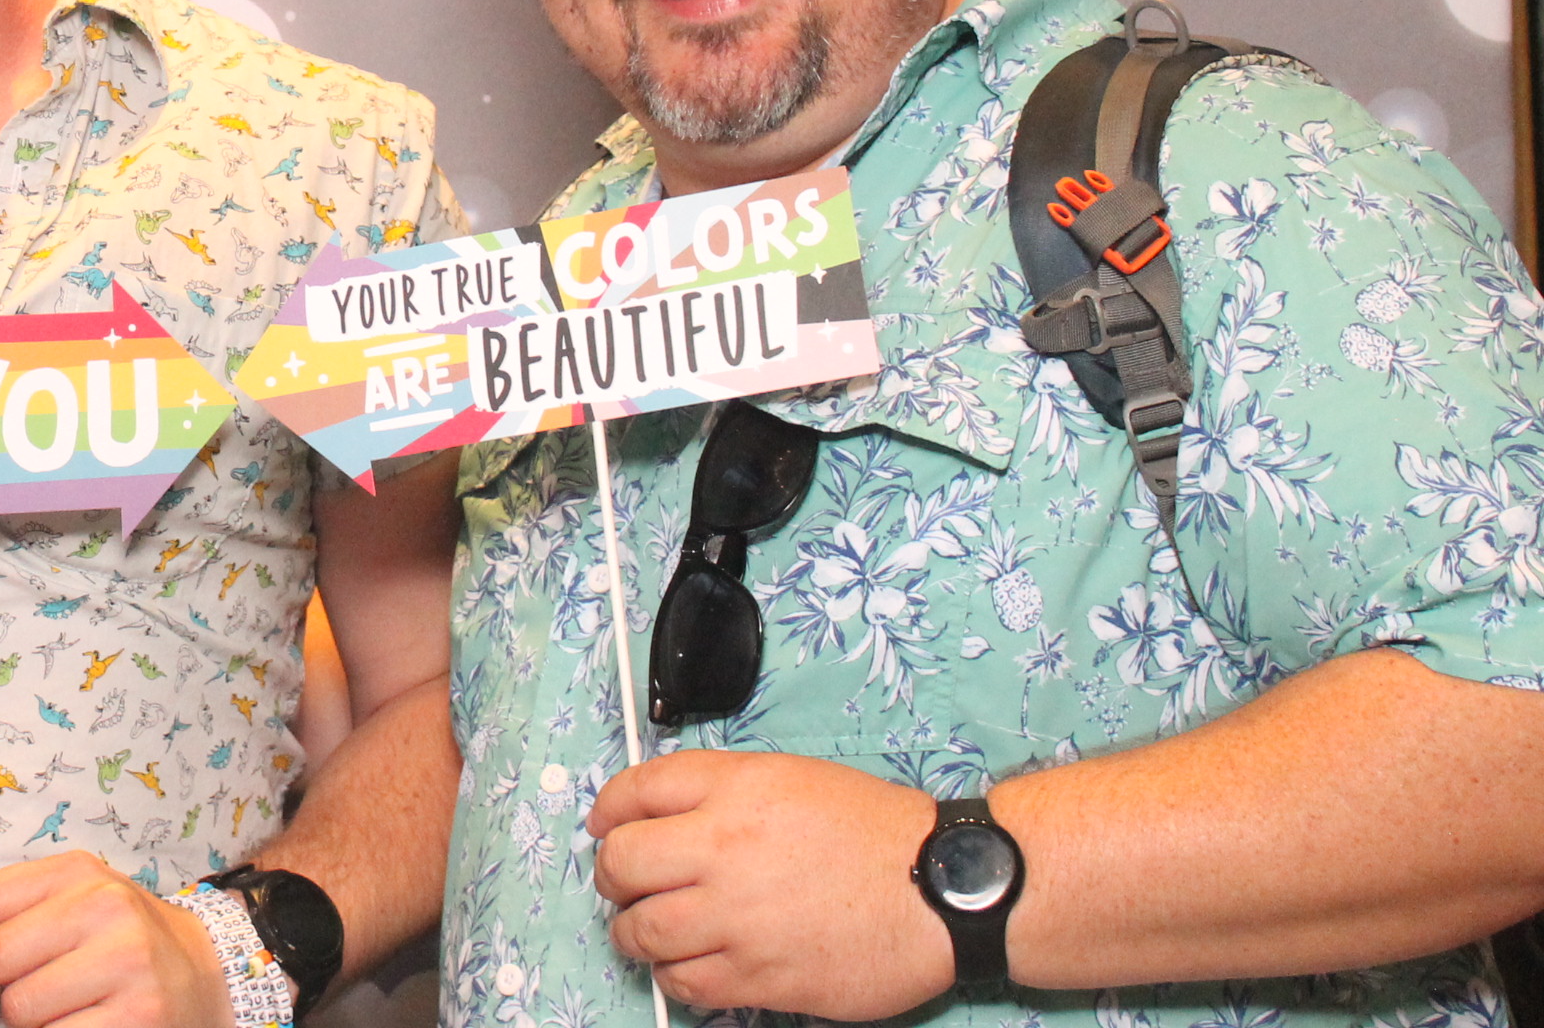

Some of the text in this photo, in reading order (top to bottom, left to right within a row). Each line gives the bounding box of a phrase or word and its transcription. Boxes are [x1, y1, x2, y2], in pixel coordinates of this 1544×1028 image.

[331, 187, 829, 335] YOUR TRUE COLORS
[364, 284, 785, 414] ARE BEAUTIFUL
